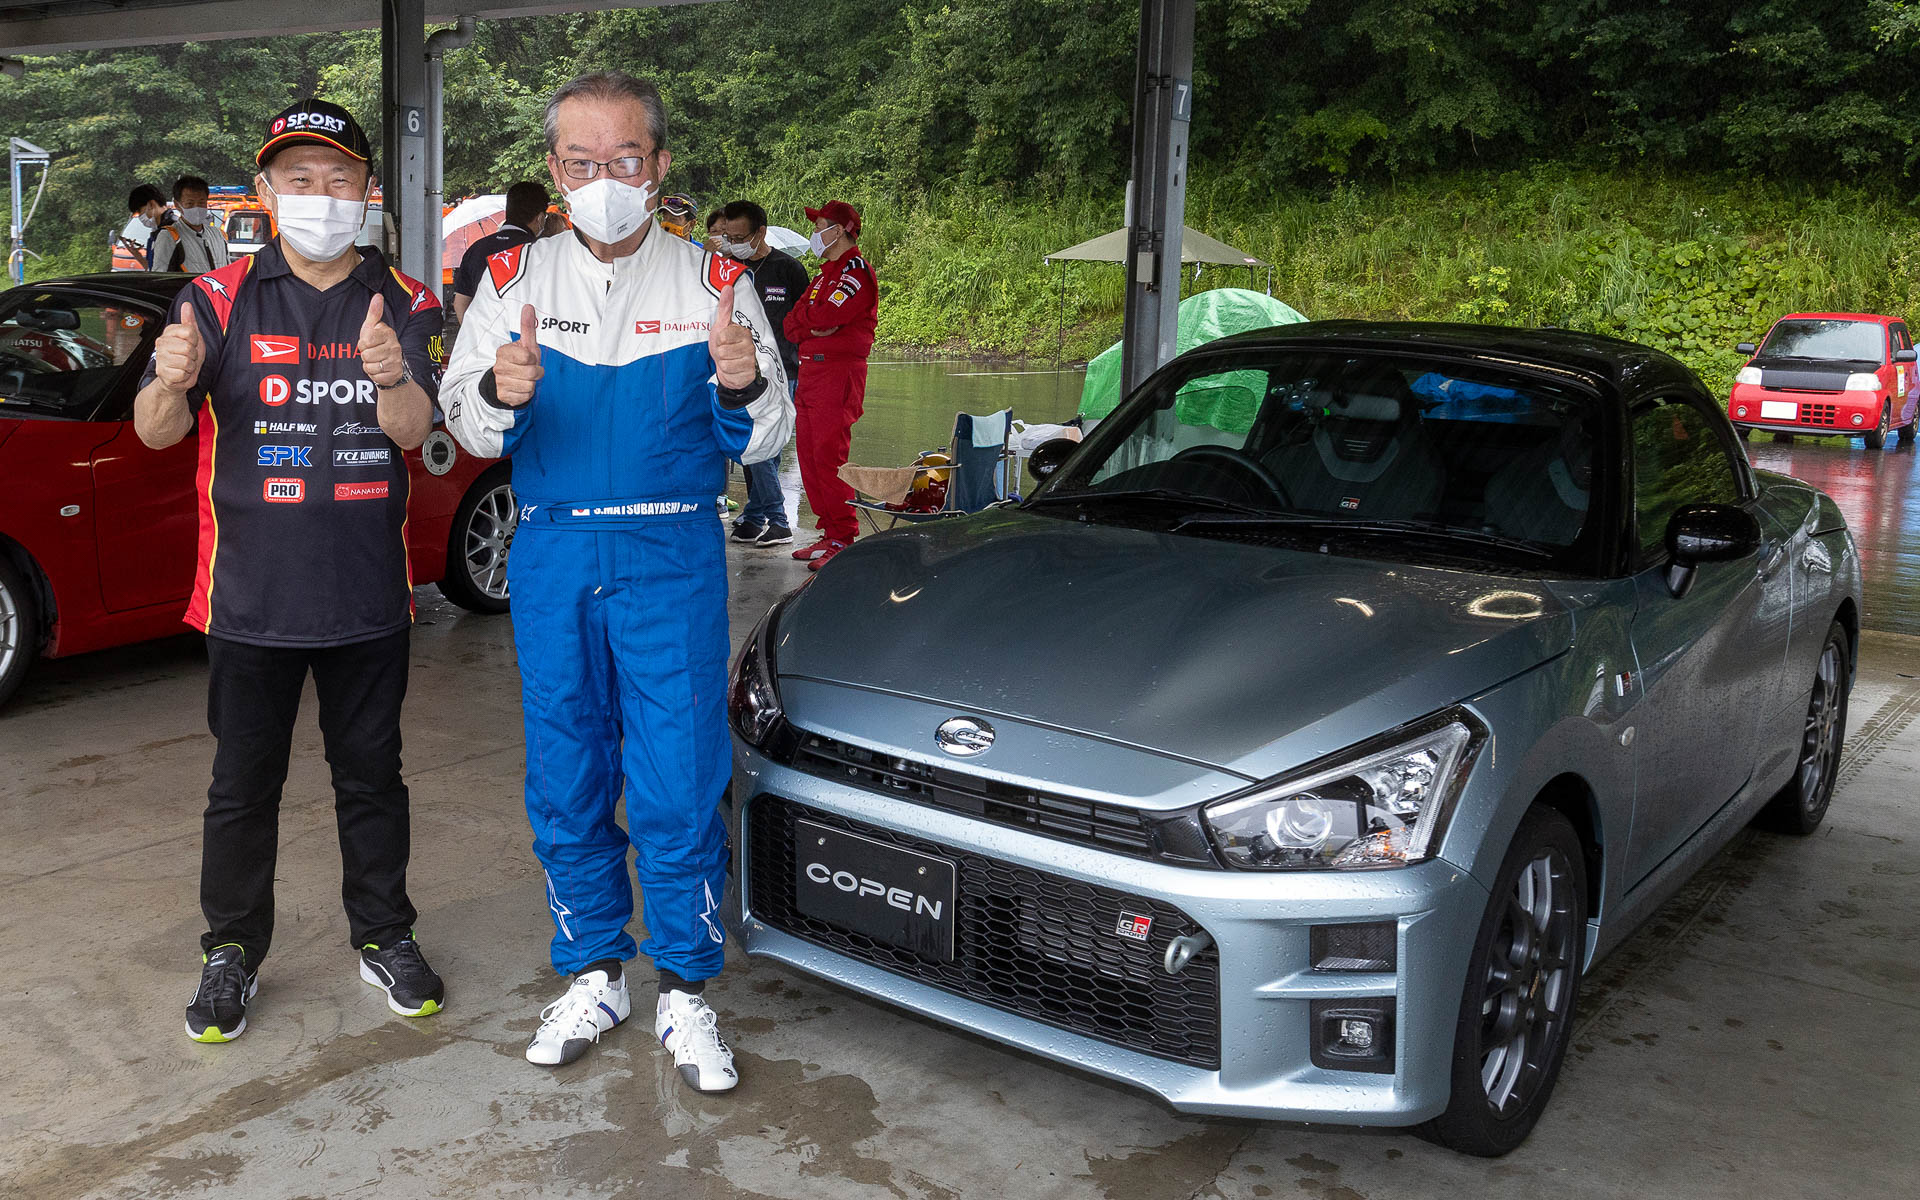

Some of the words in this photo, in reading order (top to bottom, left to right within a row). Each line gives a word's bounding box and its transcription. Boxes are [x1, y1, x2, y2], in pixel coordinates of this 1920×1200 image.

[1178, 84, 1188, 115] 7
[272, 118, 285, 133] D
[287, 113, 346, 131] SPORT
[408, 110, 420, 133] 6
[541, 317, 590, 334] SPORT
[263, 376, 290, 404] D
[295, 379, 376, 404] SPOR
[269, 422, 296, 432] HALF
[297, 423, 317, 433] WAY
[257, 445, 313, 467] SPK
[336, 451, 359, 461] TCL
[360, 450, 389, 460] ADVANCE
[271, 484, 297, 496] PRO
[1341, 501, 1358, 509] GR
[806, 863, 942, 920] COPEN
[1120, 919, 1148, 934] GR
